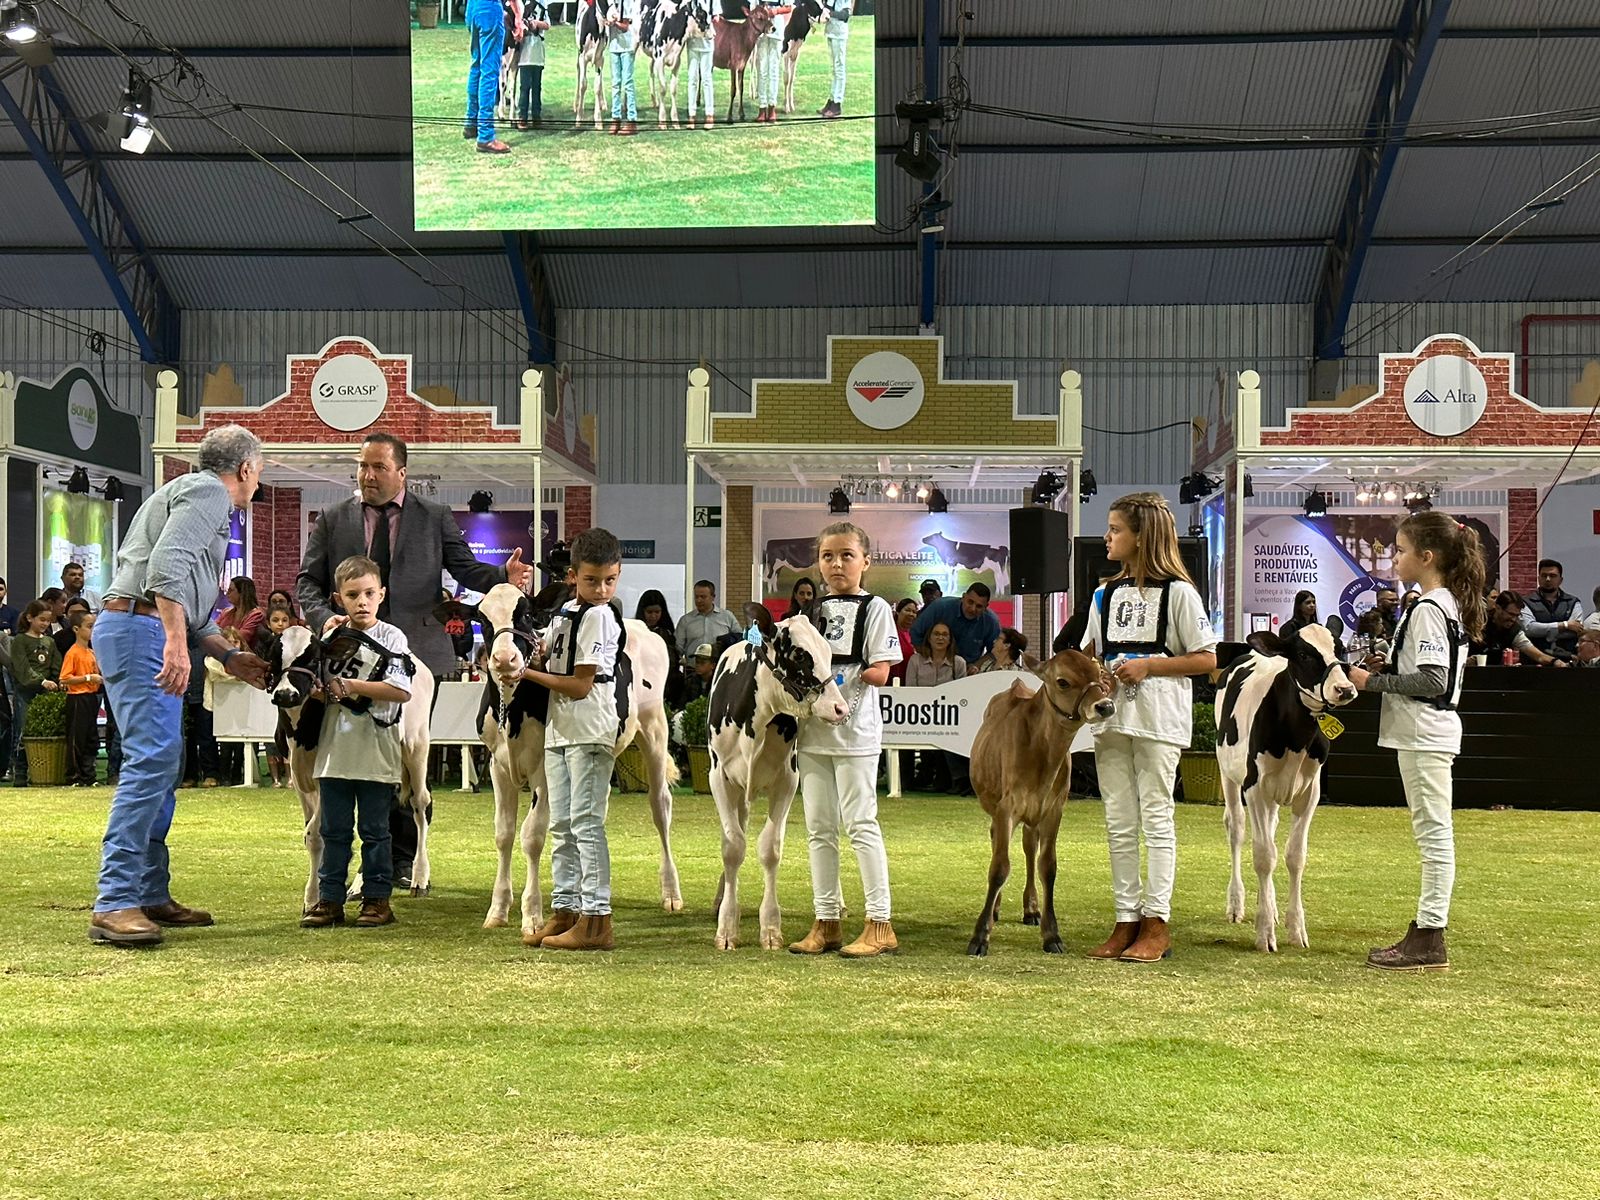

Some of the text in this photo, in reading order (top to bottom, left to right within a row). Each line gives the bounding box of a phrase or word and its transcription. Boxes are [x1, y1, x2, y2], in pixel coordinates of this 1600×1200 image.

[1443, 388, 1477, 404] Alta
[905, 551, 935, 560] LEITE
[1254, 542, 1313, 558] SAUDÁVEIS,
[1254, 558, 1318, 570] PRODUTIVAS
[1254, 569, 1319, 583] E RENTÁVEIS
